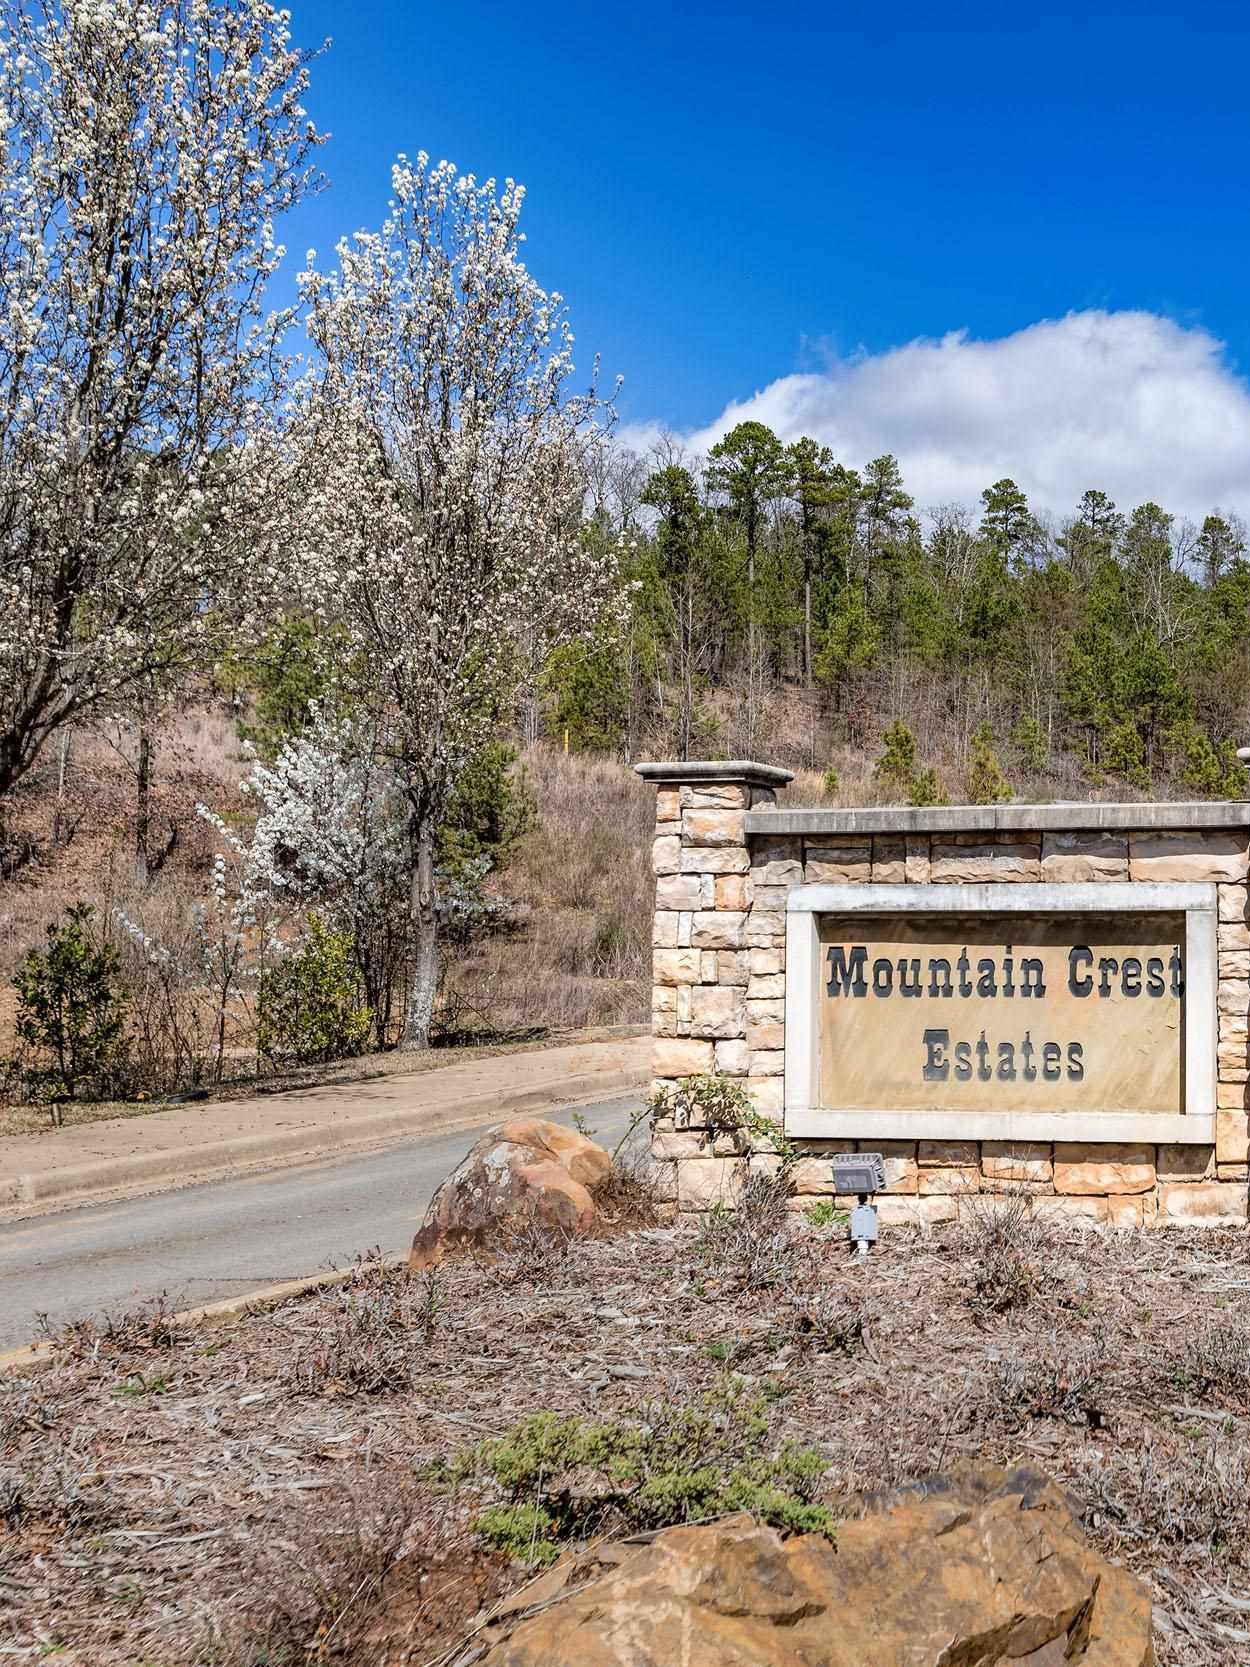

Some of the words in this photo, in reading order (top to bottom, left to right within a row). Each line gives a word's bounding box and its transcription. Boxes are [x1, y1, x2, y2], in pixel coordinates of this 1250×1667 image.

[826, 945, 1046, 998] Mountain
[1067, 944, 1185, 998] Crest
[922, 1028, 1084, 1081] Estates
